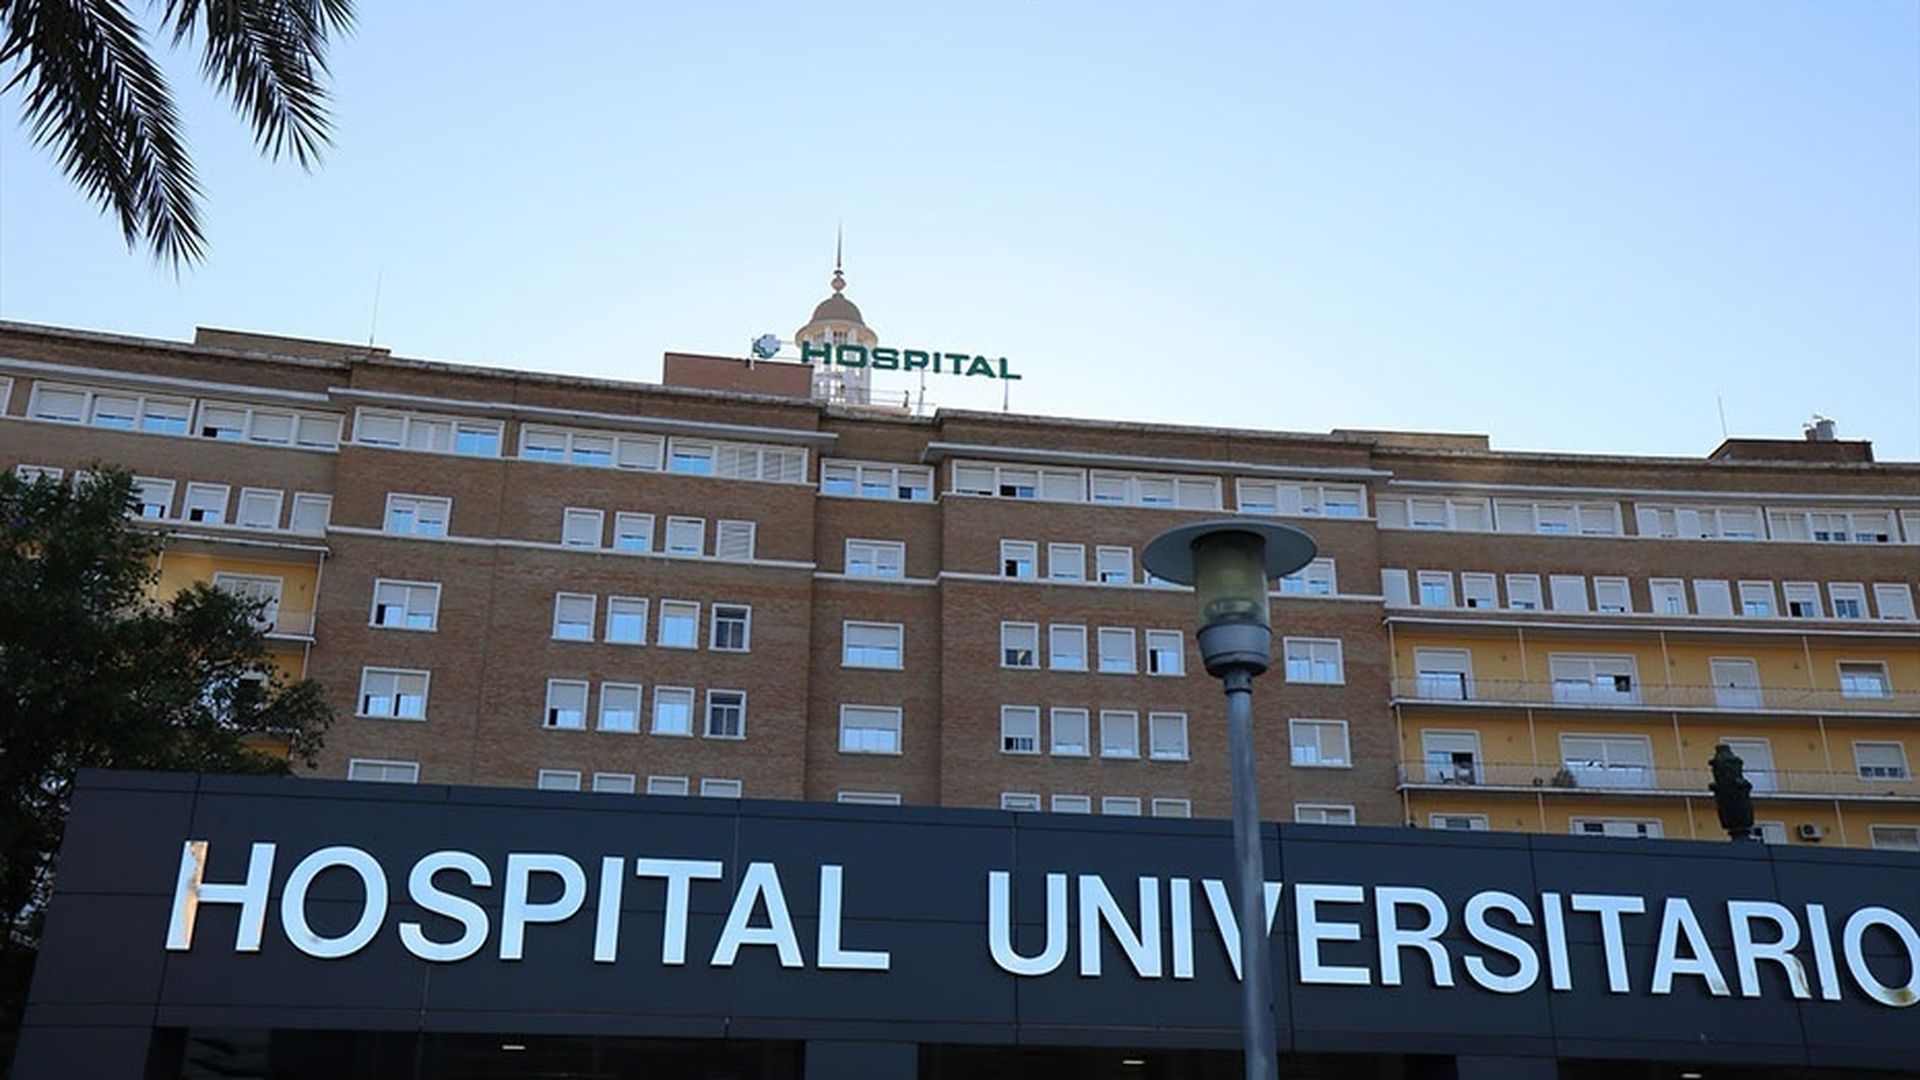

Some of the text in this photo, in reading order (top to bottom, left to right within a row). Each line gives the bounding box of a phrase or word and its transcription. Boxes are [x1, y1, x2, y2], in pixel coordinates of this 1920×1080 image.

[801, 341, 1022, 380] HOSPITAL
[165, 840, 1920, 1007] HOSPITAL UNIVERSITARIO
